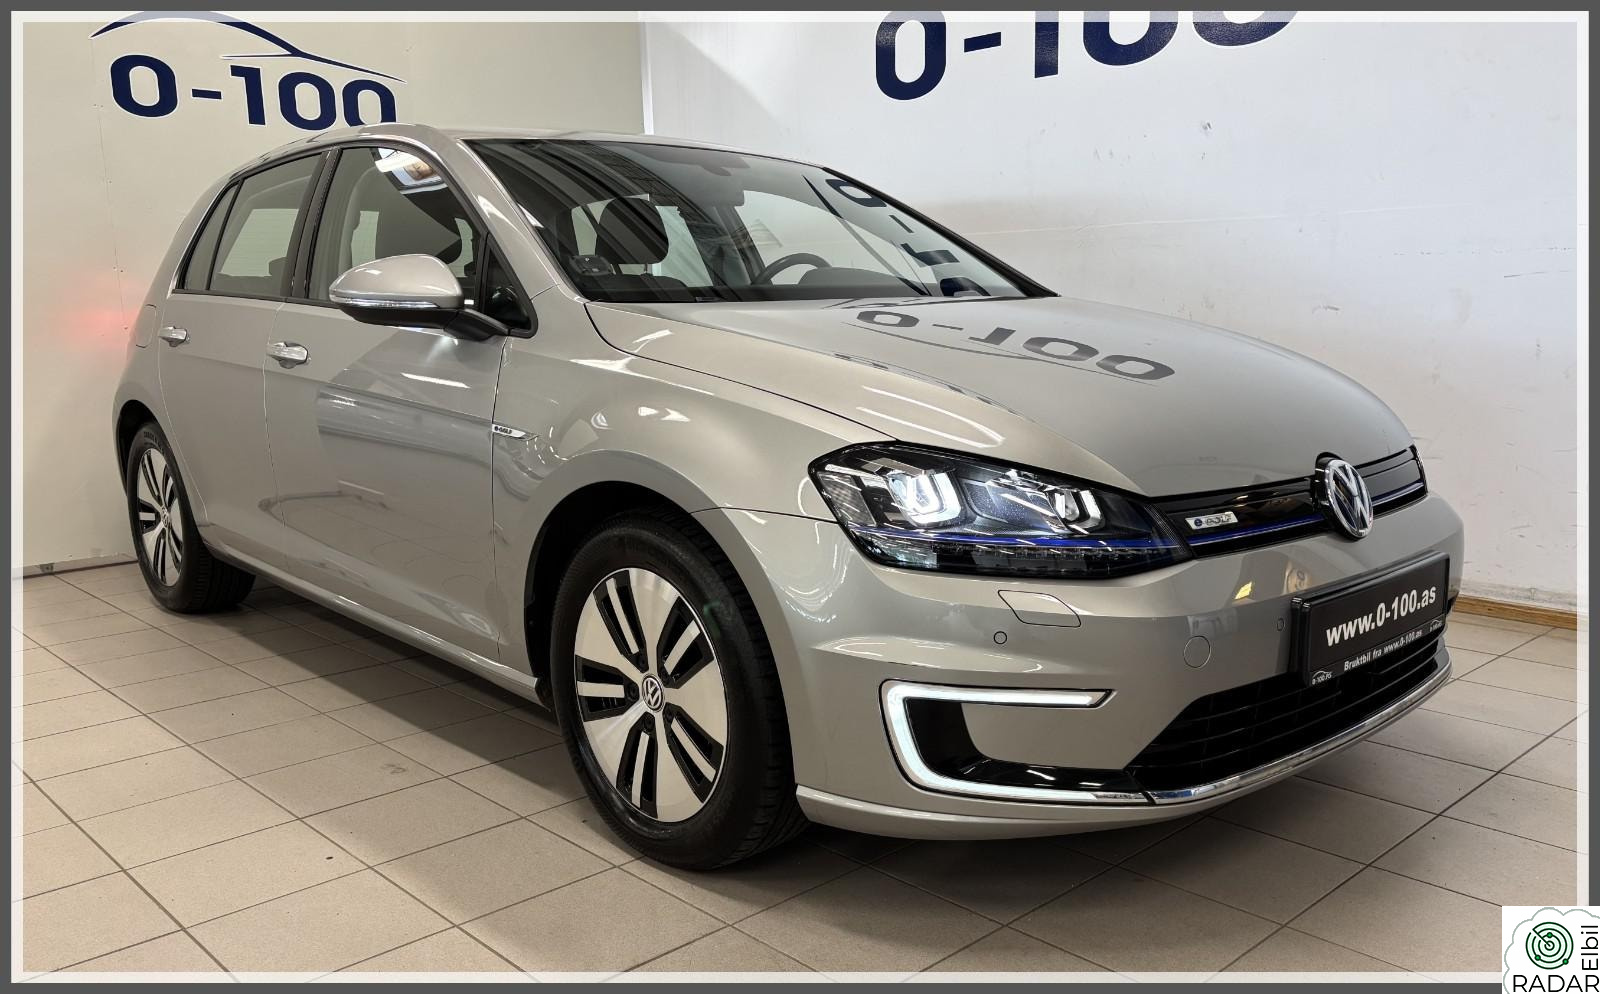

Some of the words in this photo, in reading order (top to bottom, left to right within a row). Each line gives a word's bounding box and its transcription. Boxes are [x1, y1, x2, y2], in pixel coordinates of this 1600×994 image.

[110, 54, 397, 131] 0-100
[1326, 586, 1437, 647] www.0-100.as
[1344, 651, 1371, 671] Bruktbil
[1373, 649, 1382, 659] fra
